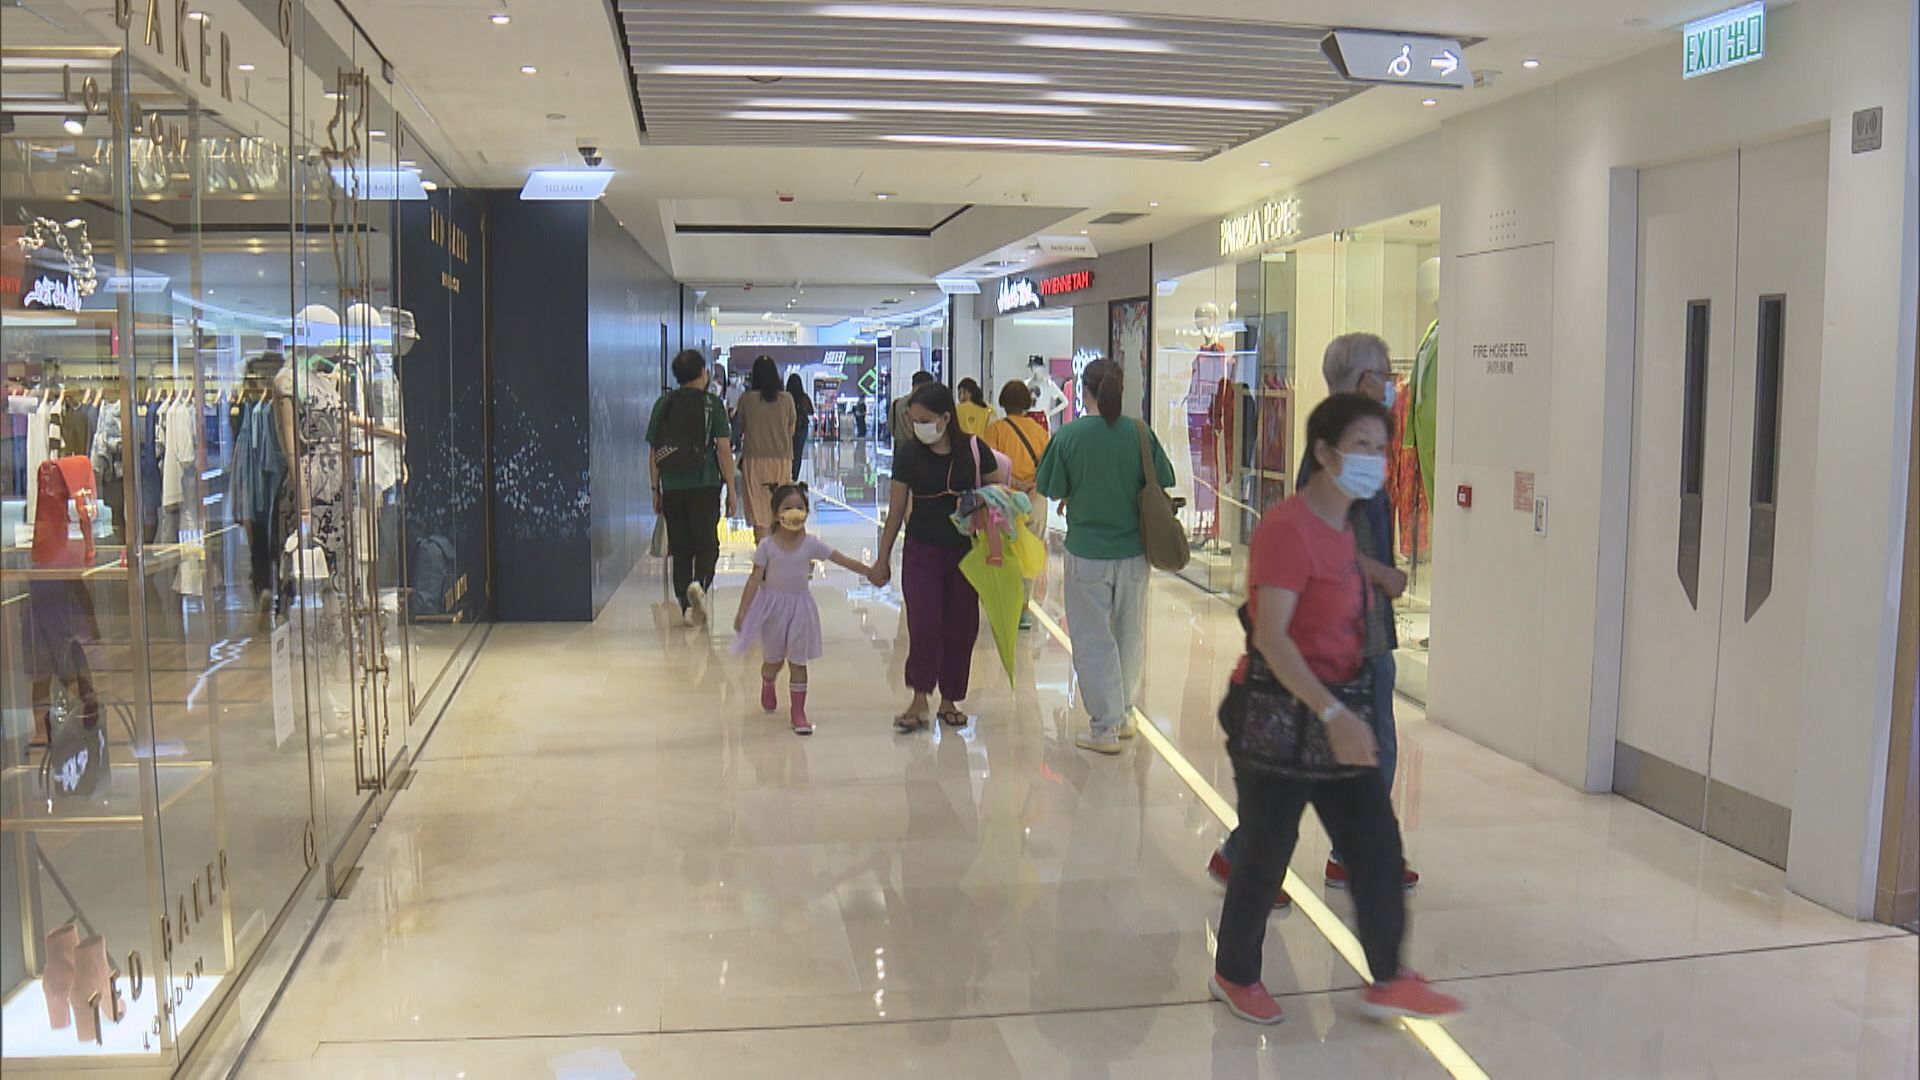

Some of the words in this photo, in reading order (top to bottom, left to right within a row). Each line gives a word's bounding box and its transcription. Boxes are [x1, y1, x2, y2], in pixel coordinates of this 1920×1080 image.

[1686, 25, 1725, 73] EXIT
[1727, 15, 1762, 62] 出口
[1263, 198, 1302, 243] PEPE
[1040, 273, 1073, 295] VIVIENNE
[1072, 270, 1090, 291] TAM
[1472, 344, 1488, 359] FIRE
[1489, 342, 1509, 359] HOSE
[1509, 342, 1529, 357] REEL
[87, 949, 143, 1047] TED
[160, 849, 229, 962] BAKER
